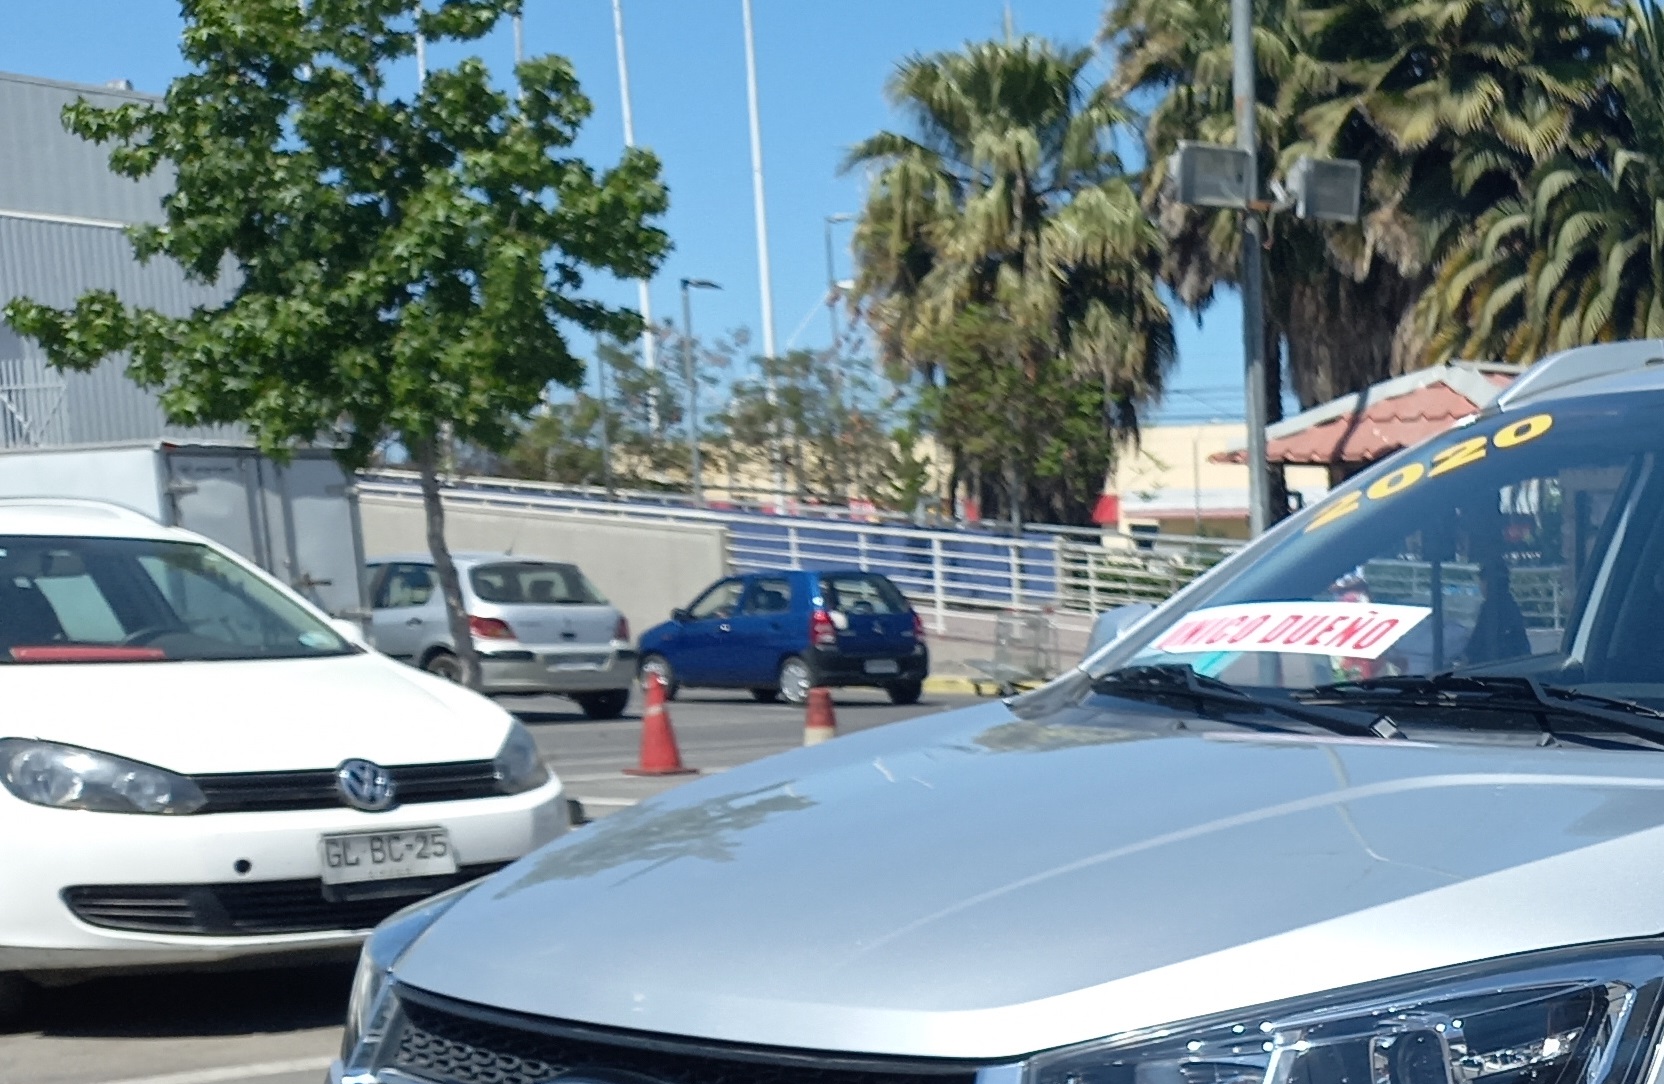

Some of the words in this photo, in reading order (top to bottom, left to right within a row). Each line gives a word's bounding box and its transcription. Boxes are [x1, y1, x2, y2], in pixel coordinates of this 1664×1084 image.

[1303, 413, 1553, 533] 2020
[1257, 610, 1400, 650] DUEÑO
[324, 838, 361, 868] GL
